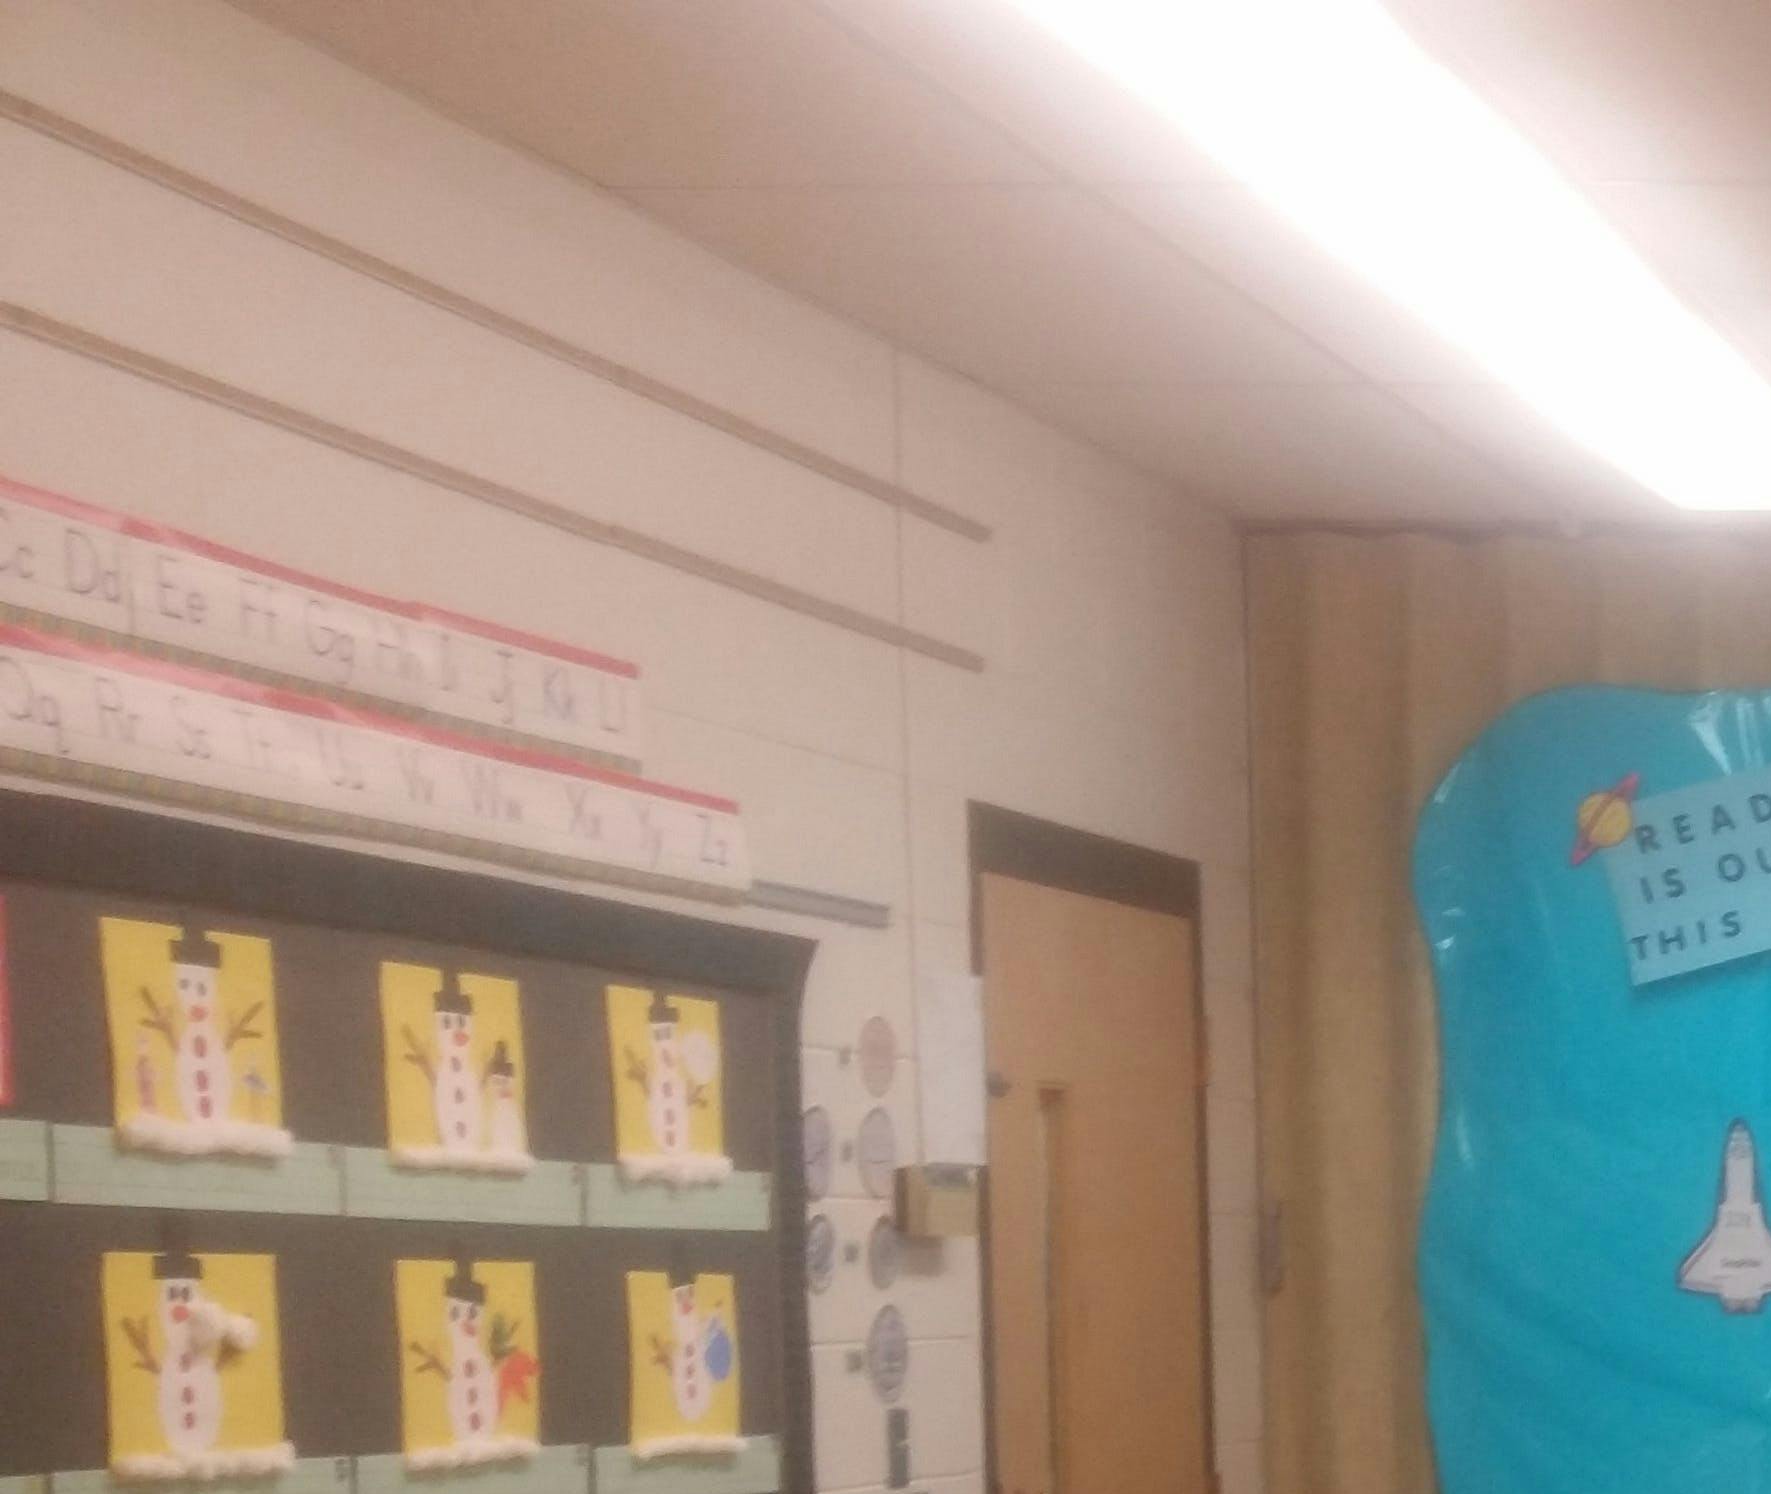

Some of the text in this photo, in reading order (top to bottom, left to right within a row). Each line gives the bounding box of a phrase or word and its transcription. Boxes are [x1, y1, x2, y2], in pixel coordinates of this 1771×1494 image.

[64, 526, 122, 604] Dd
[156, 553, 207, 625] Ee
[238, 576, 280, 646] Ff
[304, 598, 356, 685] Gg
[93, 676, 141, 744] Rr
[170, 694, 212, 760] Ss
[696, 812, 729, 867] Zz
[1629, 909, 1743, 961] THIS
[1640, 866, 1687, 905] IS
